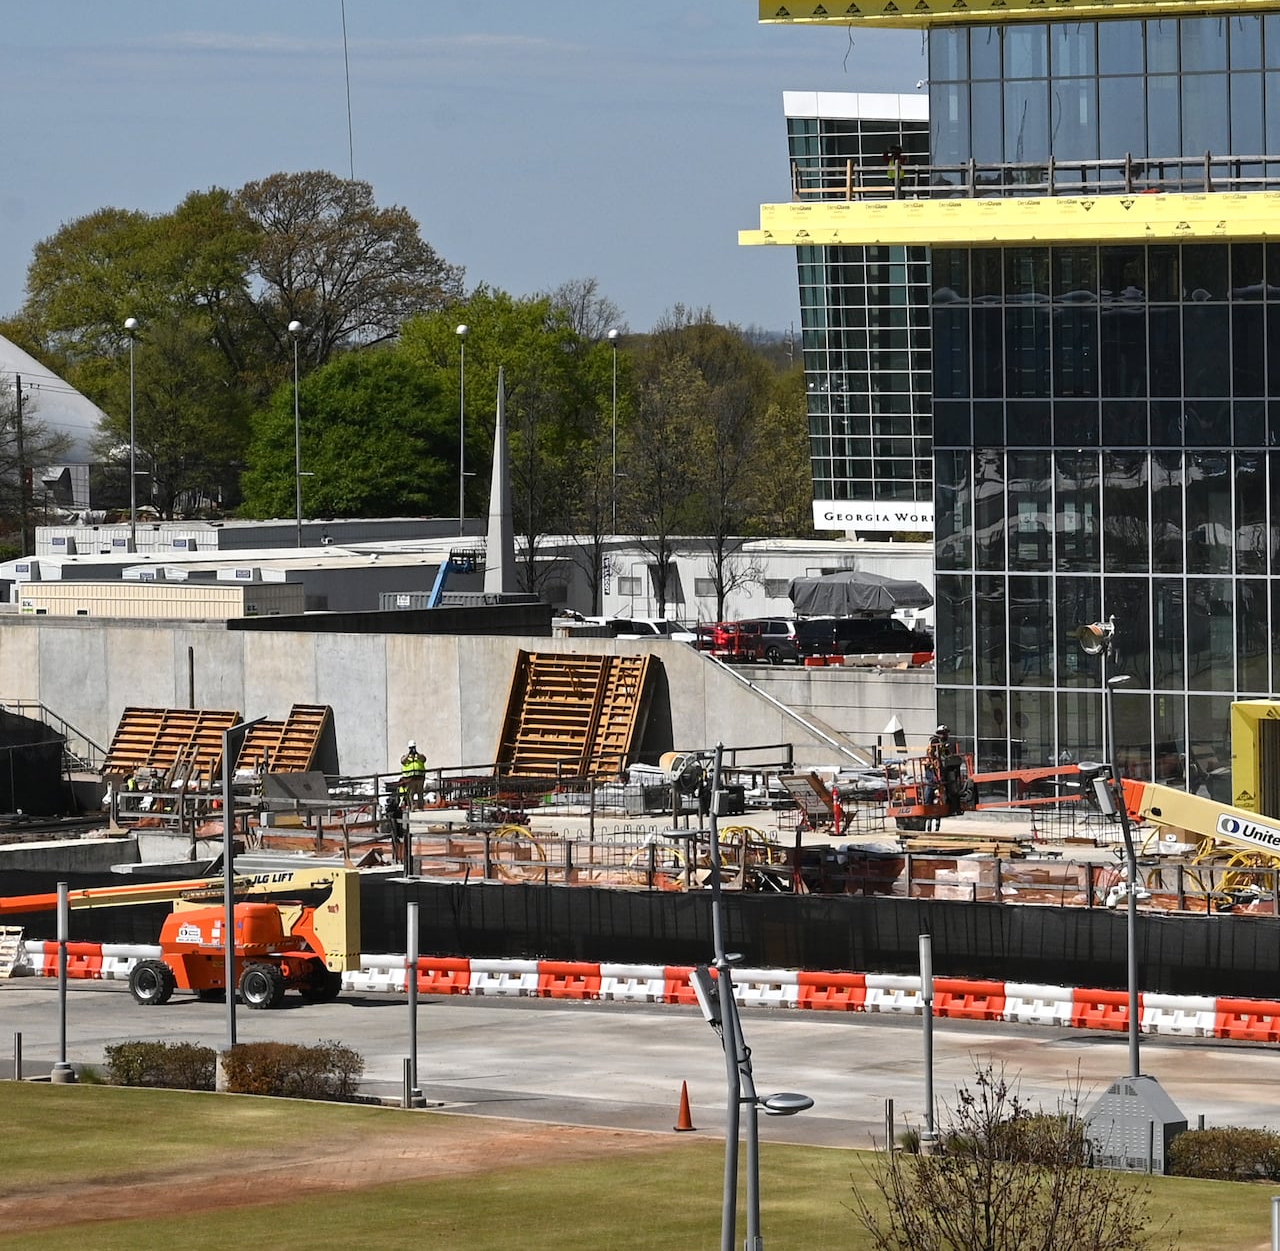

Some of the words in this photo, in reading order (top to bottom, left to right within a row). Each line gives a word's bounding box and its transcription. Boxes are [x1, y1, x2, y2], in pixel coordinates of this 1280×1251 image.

[824, 512, 890, 522] GEORGIA
[252, 874, 270, 884] JLG
[271, 872, 294, 883] LIFT
